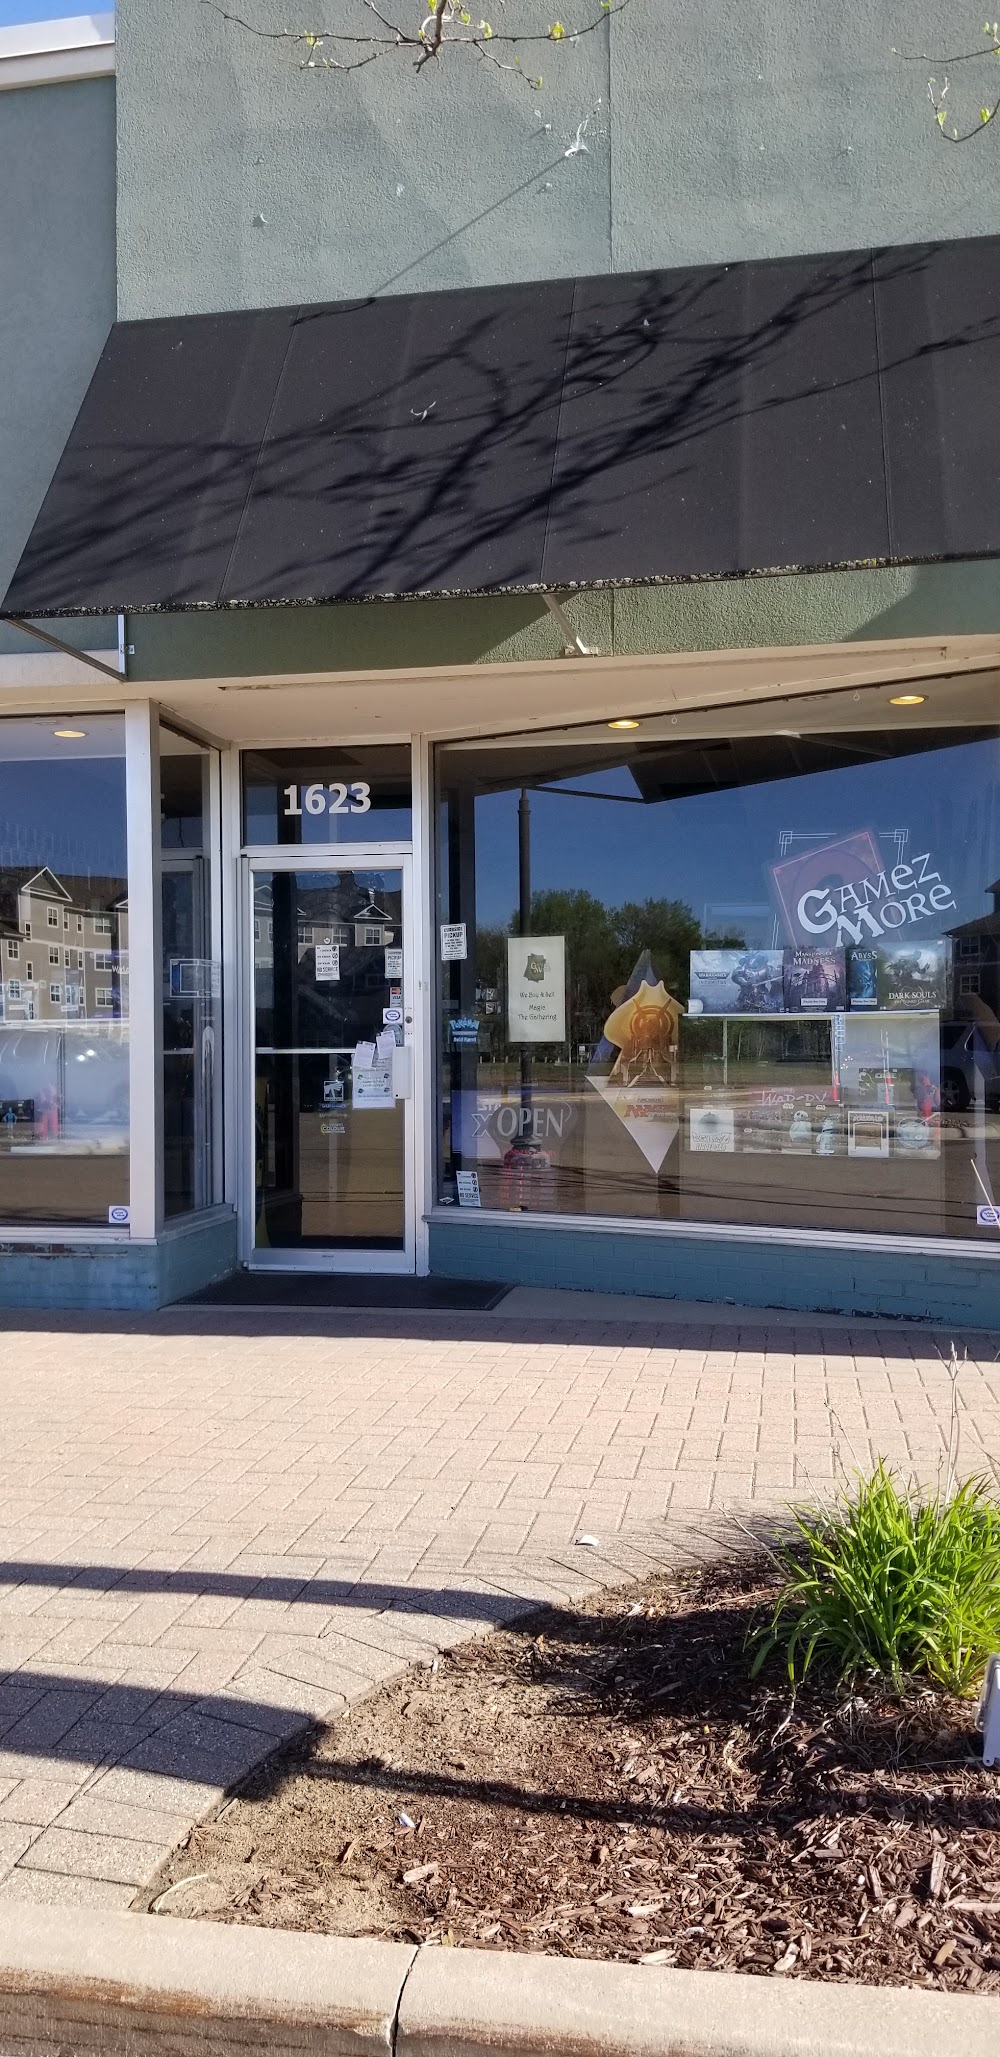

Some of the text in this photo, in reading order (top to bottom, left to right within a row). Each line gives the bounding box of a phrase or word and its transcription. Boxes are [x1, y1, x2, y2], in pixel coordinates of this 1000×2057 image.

[284, 782, 371, 815] 1623
[850, 950, 878, 961] ABYSS
[793, 957, 836, 966] MADNESS
[888, 991, 937, 1000] DARK SOULS
[528, 1004, 546, 1012] Magic
[518, 1013, 557, 1022] The Gathering
[497, 1107, 564, 1137] OPEN
